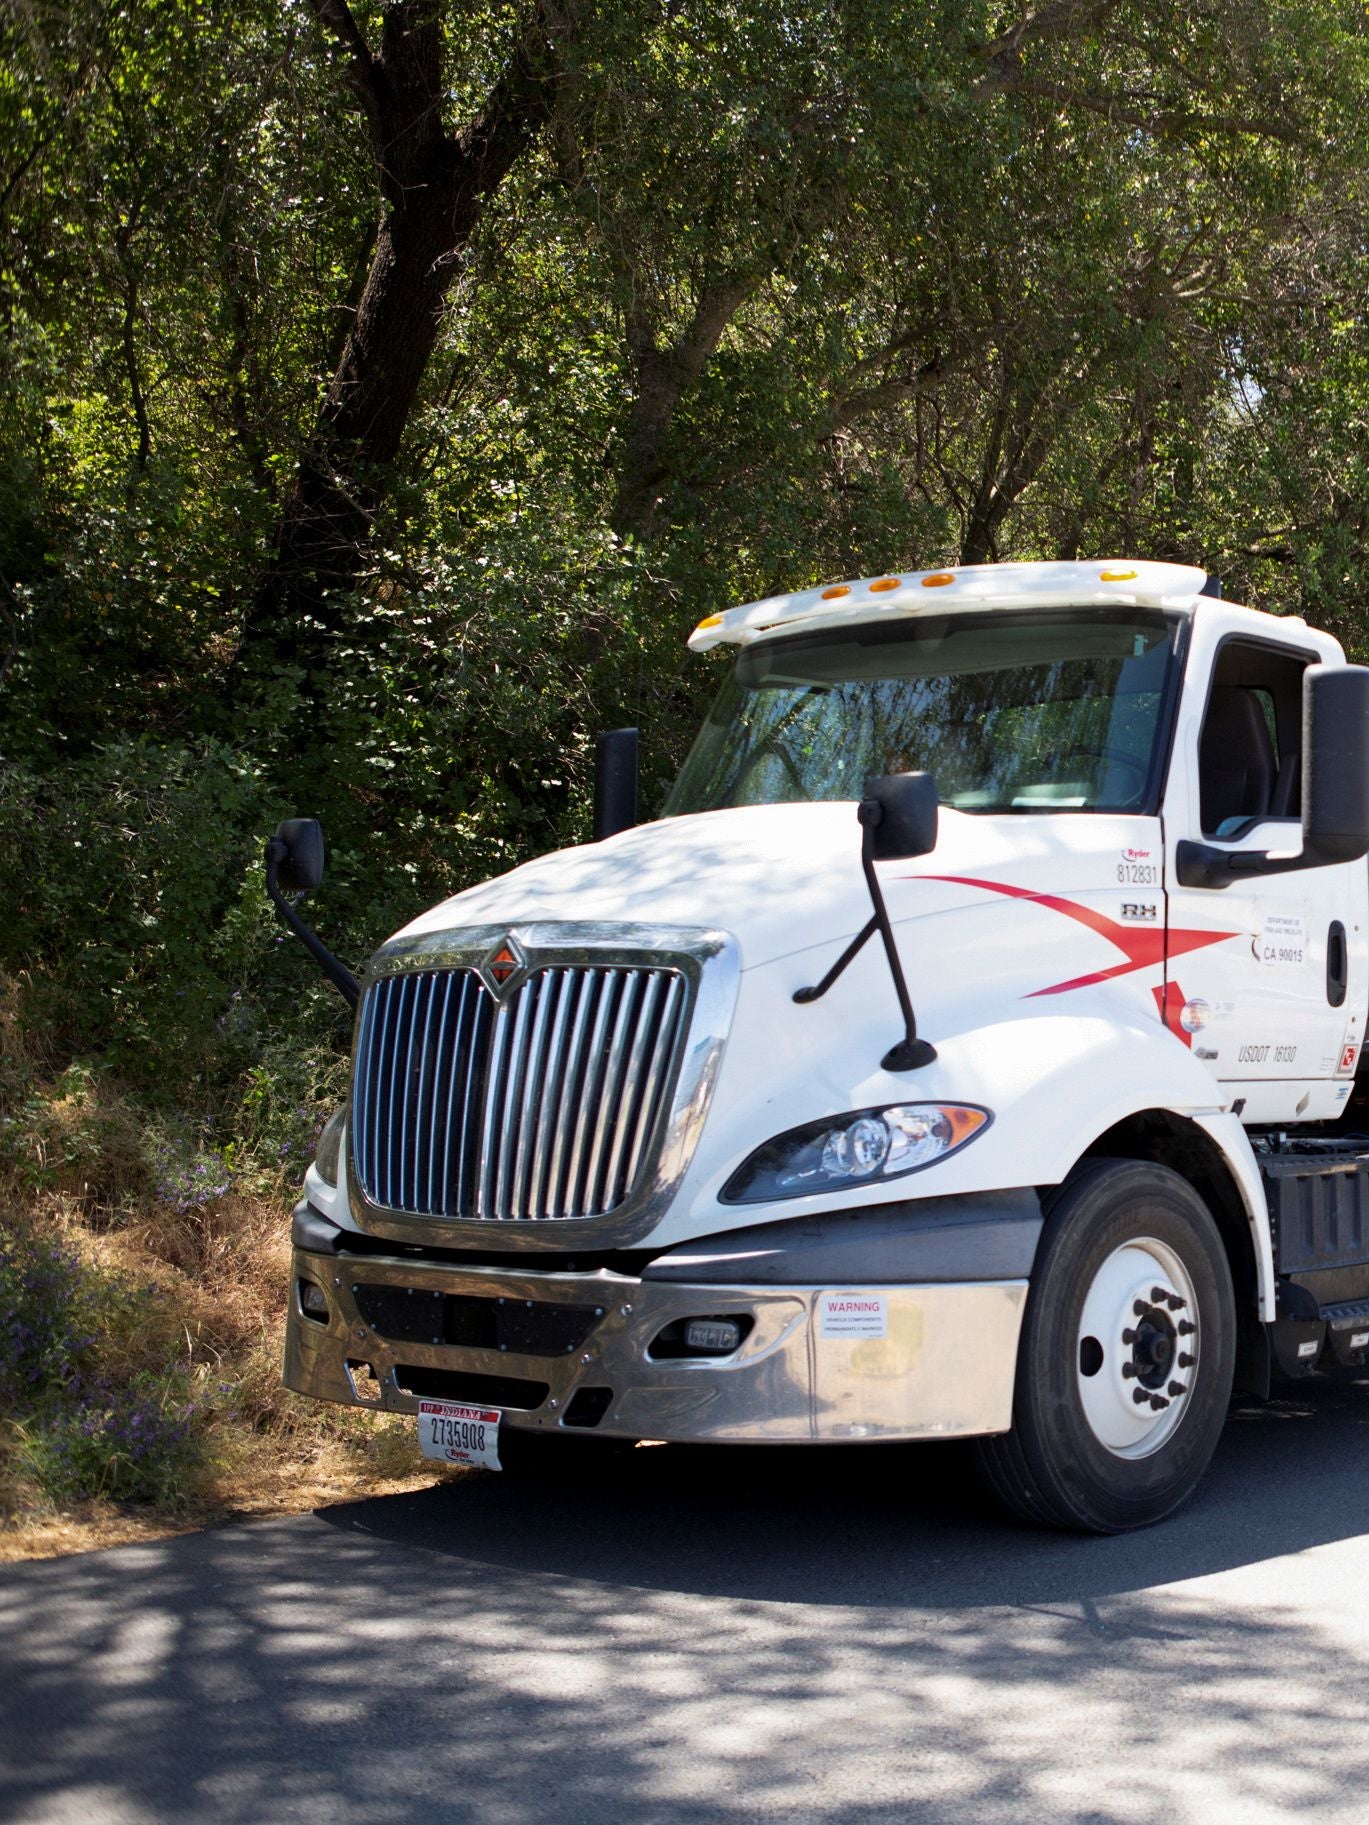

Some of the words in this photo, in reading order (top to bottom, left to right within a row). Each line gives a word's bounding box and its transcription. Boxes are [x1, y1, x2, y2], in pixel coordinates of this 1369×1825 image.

[1128, 848, 1151, 859] Ryder
[1117, 864, 1157, 884] 812831
[1122, 903, 1156, 916] RH
[1264, 947, 1276, 960] CA
[1279, 948, 1302, 962] 90015
[1238, 1045, 1271, 1062] USDOT
[1273, 1046, 1297, 1062] 16130
[827, 1301, 880, 1312] WARNING
[440, 1405, 481, 1420] INDIANA
[431, 1417, 485, 1451] 2735908
[450, 1448, 471, 1459] Ryder
